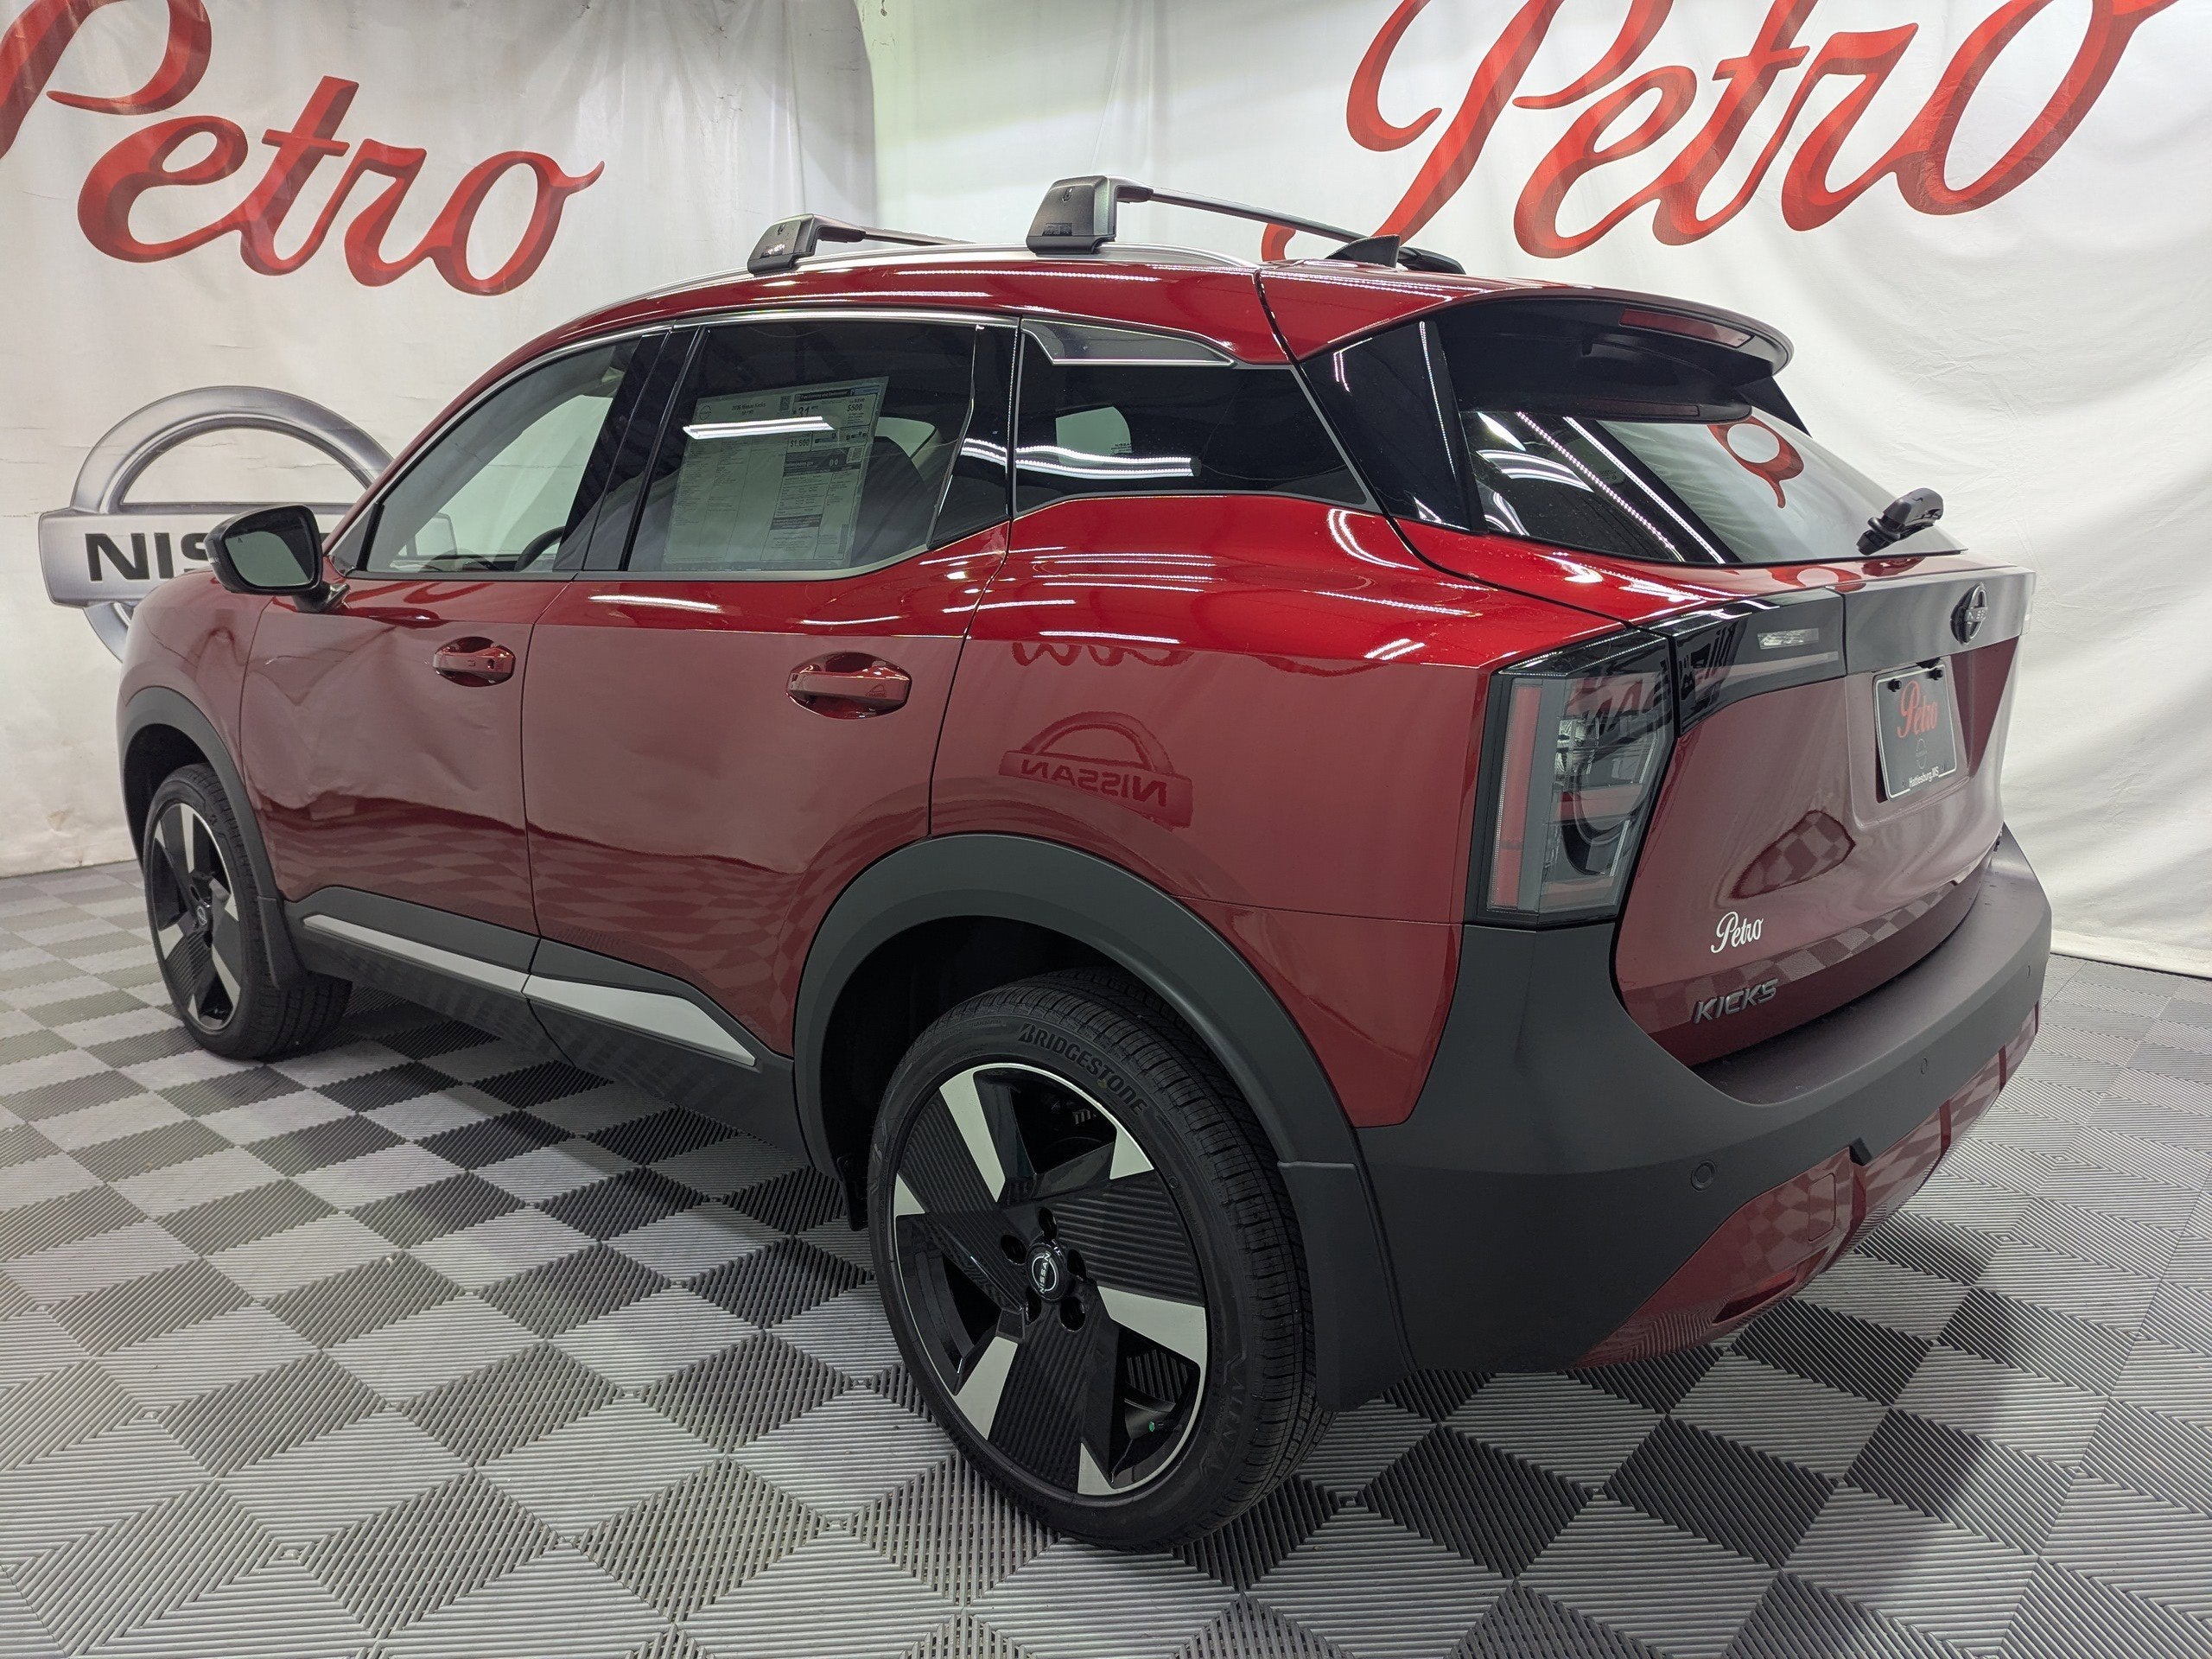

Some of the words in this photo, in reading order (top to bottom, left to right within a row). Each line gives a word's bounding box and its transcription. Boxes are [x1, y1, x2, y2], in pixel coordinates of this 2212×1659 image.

[0, 0, 604, 296] Petro
[1262, 0, 2182, 262] Petro
[1897, 680, 1938, 739] Petro
[1710, 911, 1764, 954] Petro
[1692, 978, 1778, 1024] KICKS
[1018, 1023, 1149, 1116] BRIDGESTONE
[1039, 1250, 1052, 1294] NISSAN
